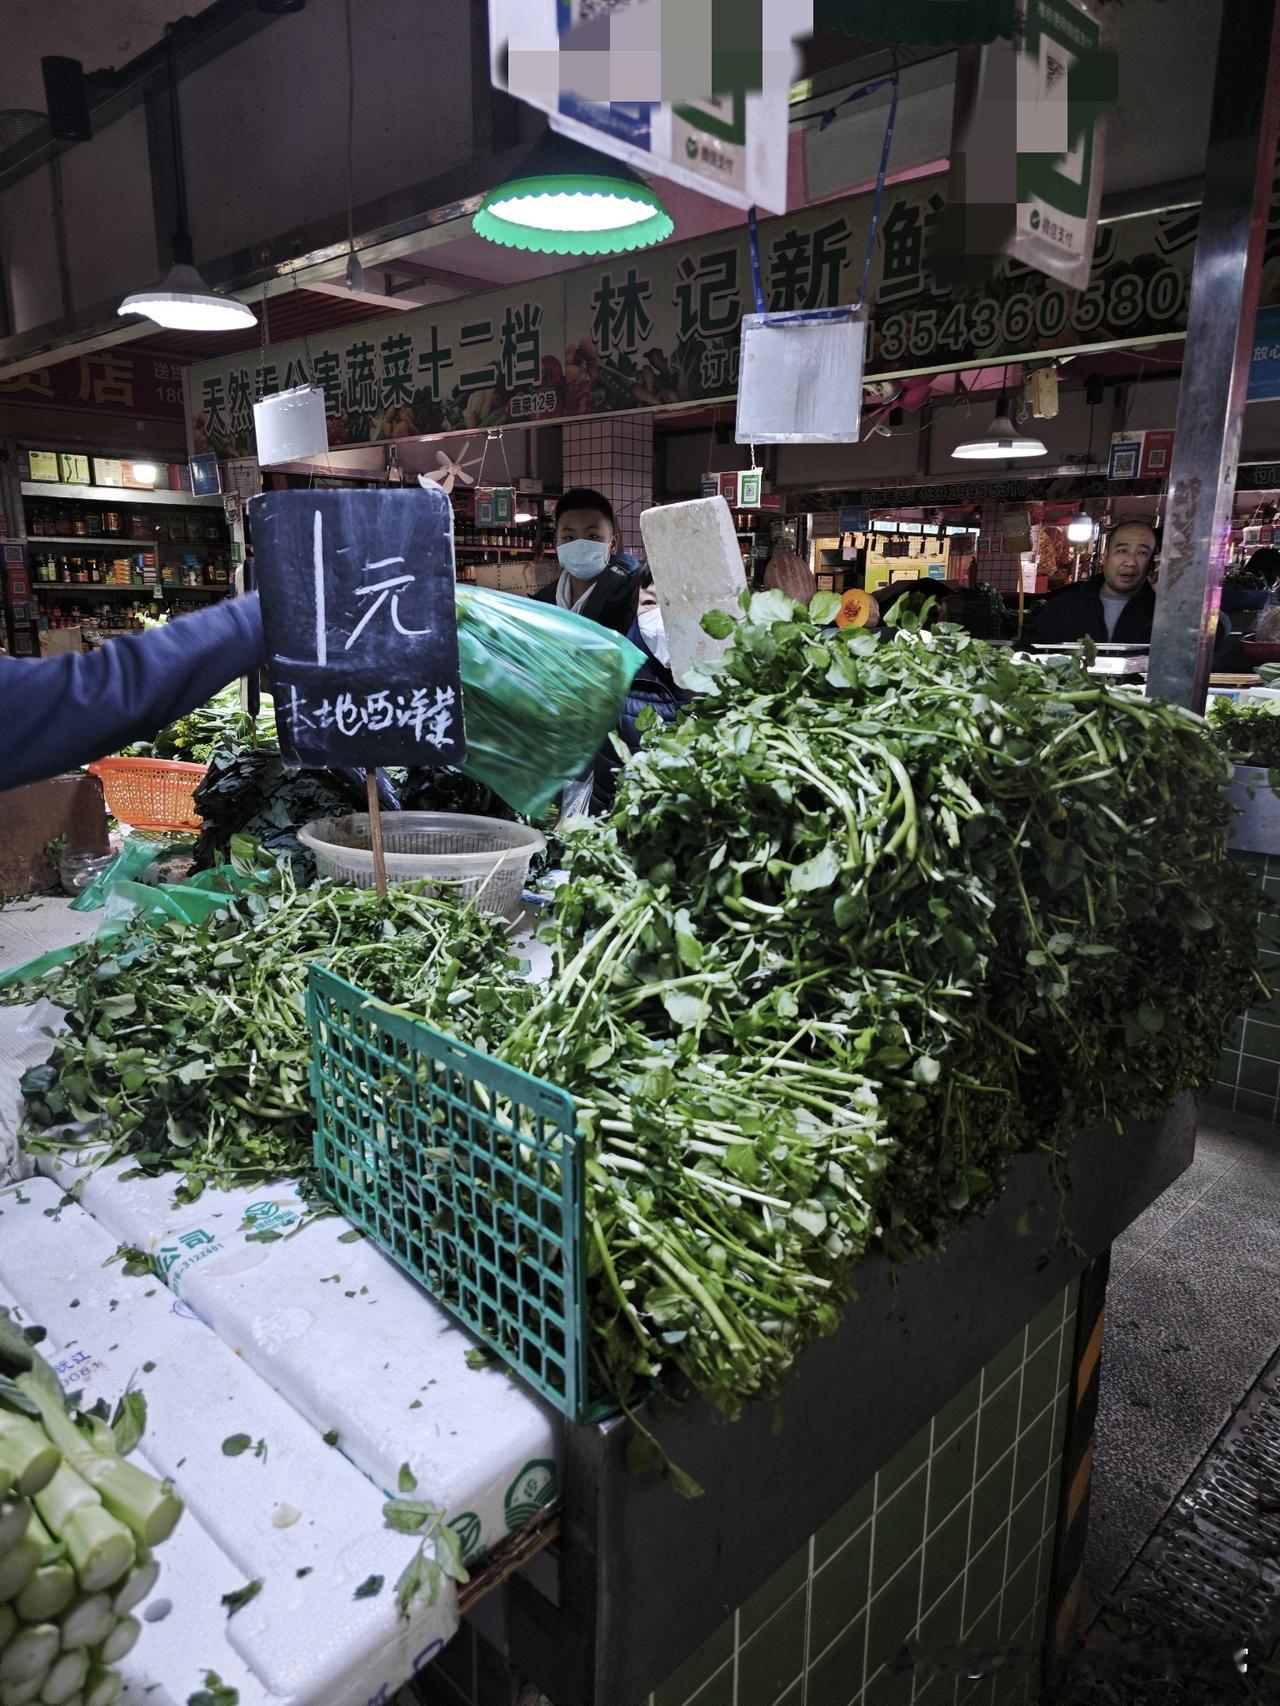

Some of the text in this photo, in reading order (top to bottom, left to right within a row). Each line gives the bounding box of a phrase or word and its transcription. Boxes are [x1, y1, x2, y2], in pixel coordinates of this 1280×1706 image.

[866, 268, 1189, 363] 1354360580
[511, 393, 556, 414] 蔬菜12号
